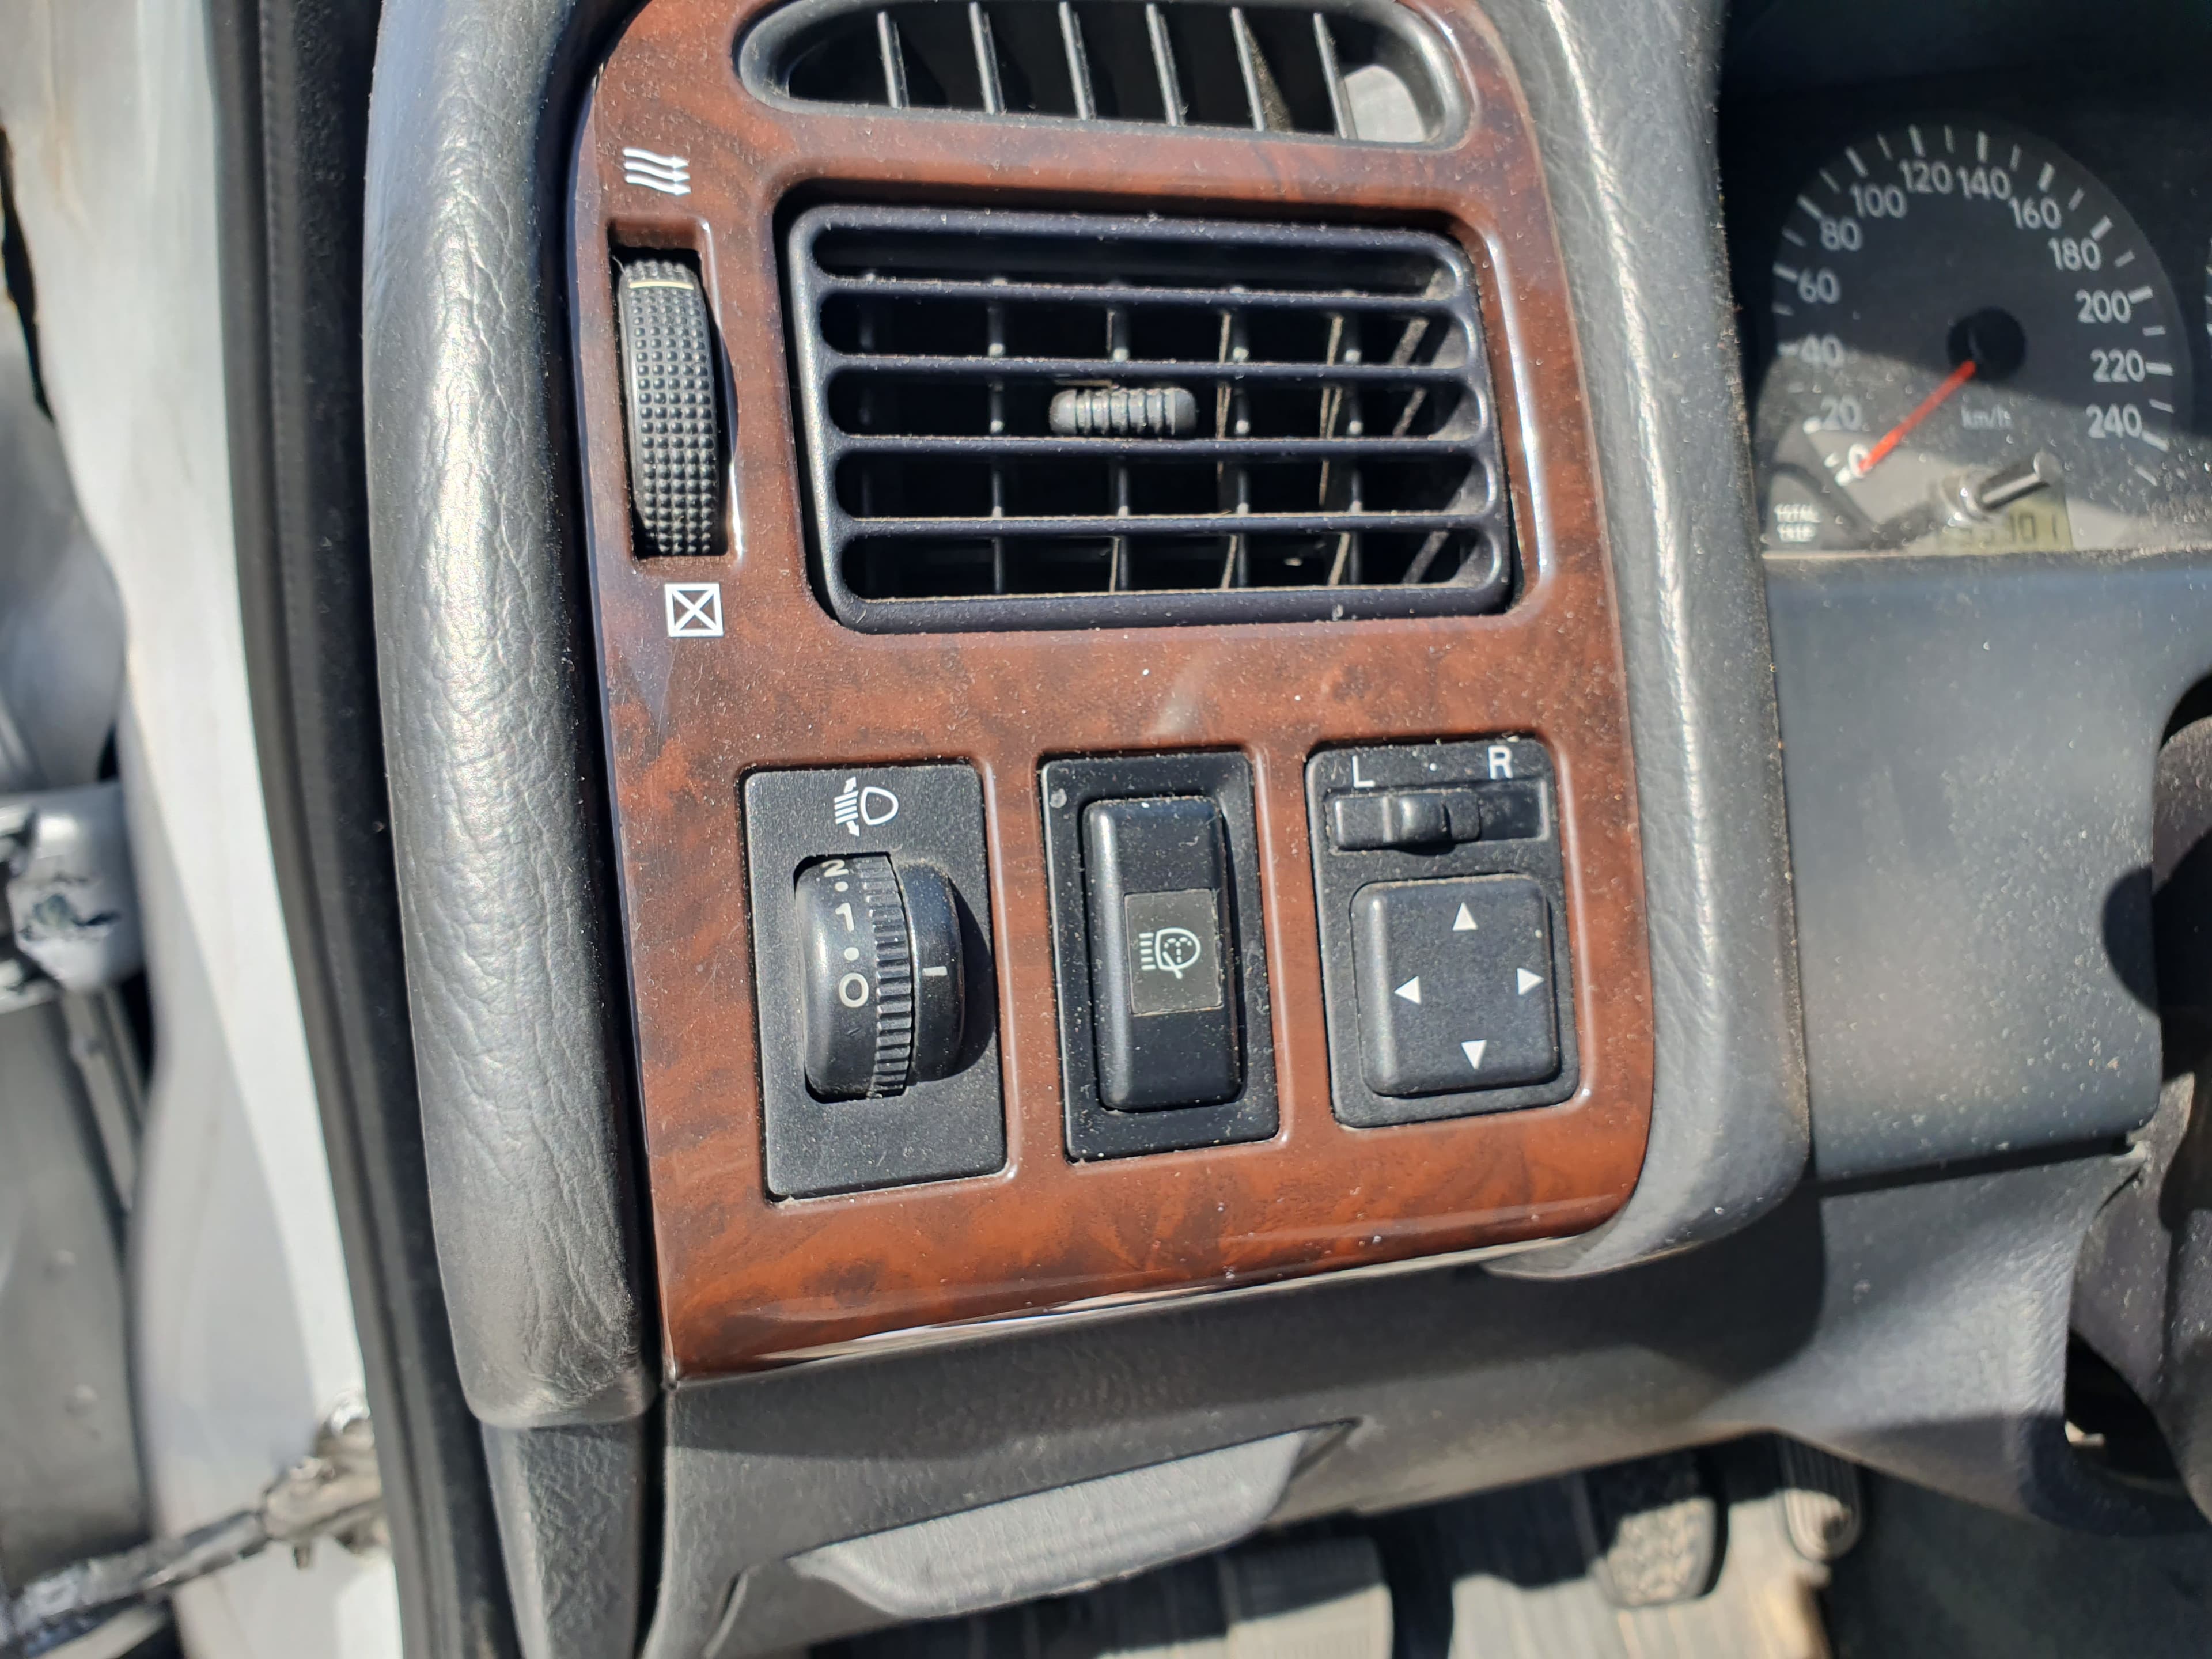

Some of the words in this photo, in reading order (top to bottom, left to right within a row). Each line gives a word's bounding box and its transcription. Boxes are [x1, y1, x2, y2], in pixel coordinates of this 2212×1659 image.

[1900, 160, 1952, 194] 120
[1958, 166, 2010, 200] 140
[1850, 183, 1907, 218] 100
[2010, 197, 2062, 230] 160
[1820, 217, 1862, 251] 80
[2048, 238, 2101, 271] 180
[1798, 267, 1839, 304] 60
[2076, 290, 2132, 323] 200
[1801, 335, 1843, 368] 40
[2091, 349, 2145, 382] 220
[1820, 395, 1862, 430] 20
[2086, 404, 2142, 438] 240
[1351, 755, 1376, 789] L
[1488, 745, 1513, 779] R
[821, 859, 849, 877] 2
[835, 902, 855, 933] 1
[839, 972, 869, 1008] 0
